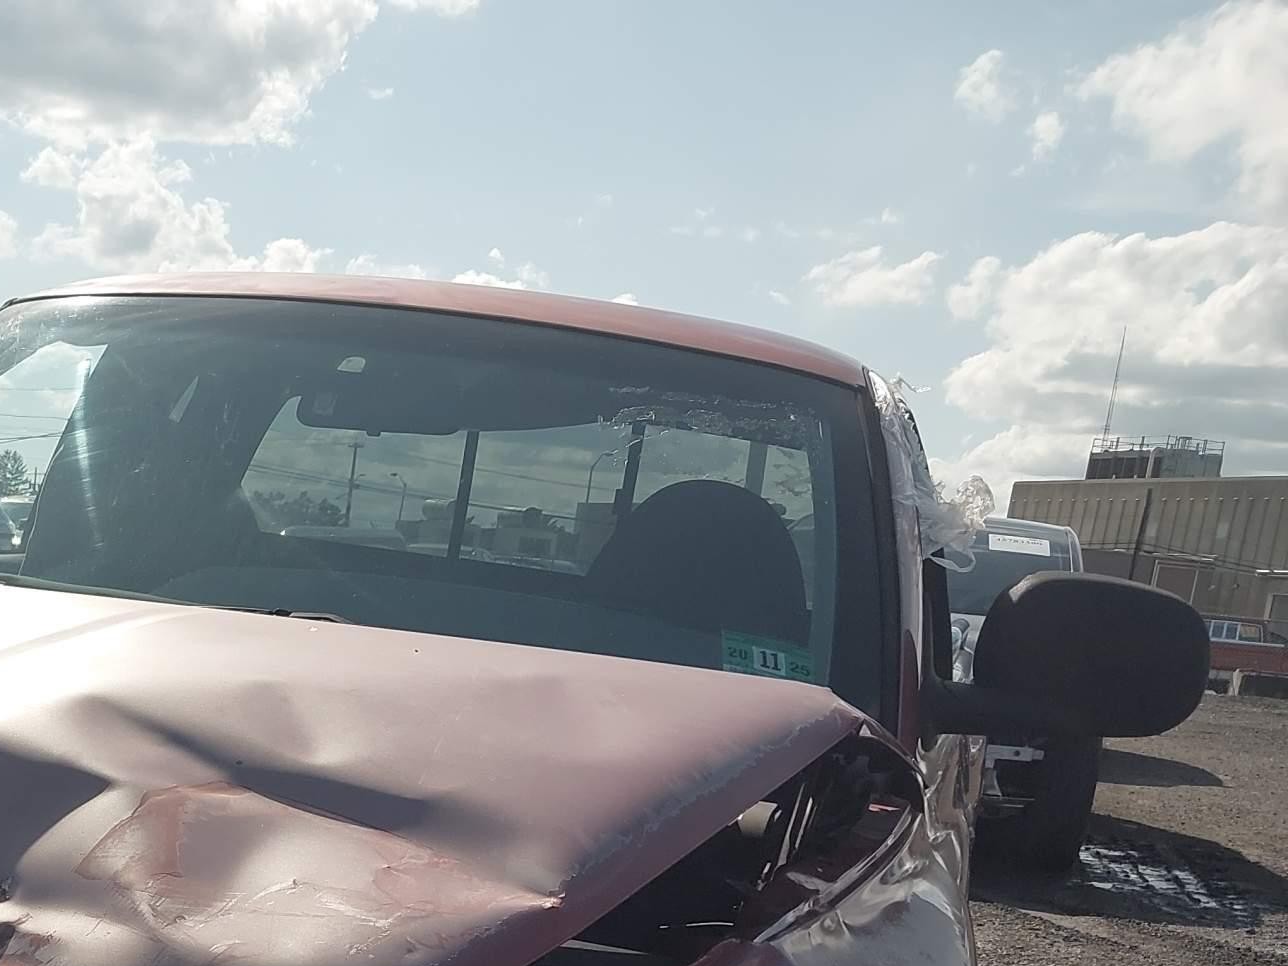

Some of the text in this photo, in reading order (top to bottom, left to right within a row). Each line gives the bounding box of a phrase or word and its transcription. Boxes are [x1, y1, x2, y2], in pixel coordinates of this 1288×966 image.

[727, 646, 748, 660] 20
[759, 650, 782, 672] 11
[789, 661, 810, 677] 25
